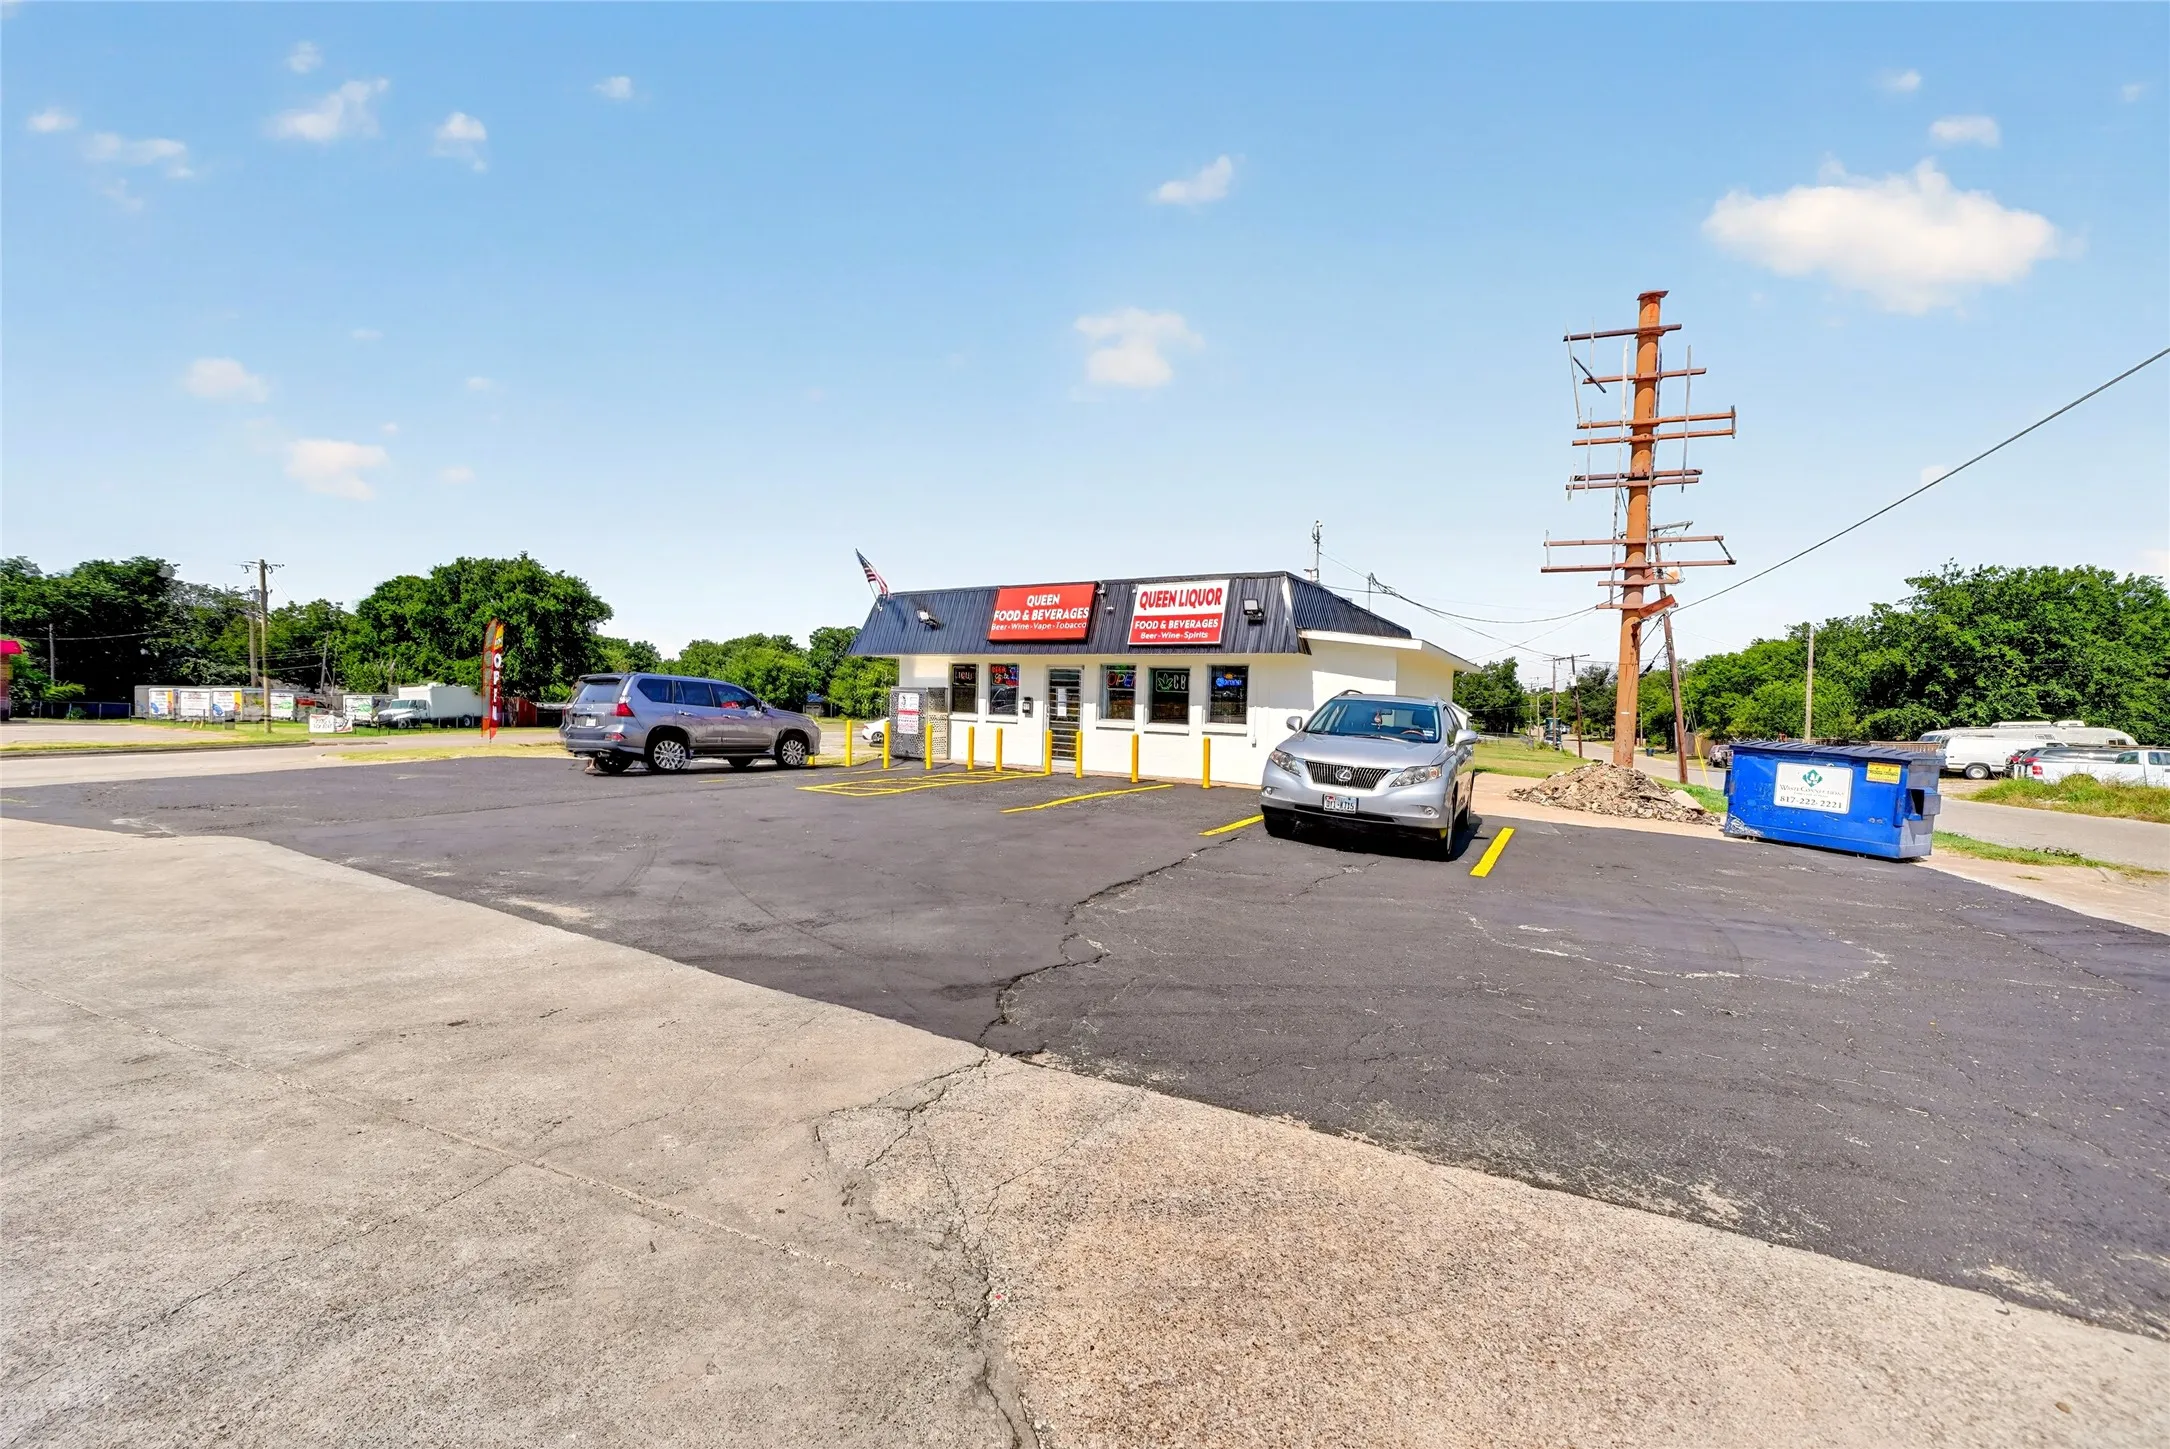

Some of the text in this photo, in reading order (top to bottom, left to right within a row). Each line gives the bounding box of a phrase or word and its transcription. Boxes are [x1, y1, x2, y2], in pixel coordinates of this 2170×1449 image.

[1026, 593, 1061, 607] QUEEN
[1139, 587, 1222, 610] QUEEN LIQUOR
[993, 607, 1090, 621] FOOD & BEVERAGES
[1135, 618, 1218, 629] FOOD & BEVERAGES
[1173, 674, 1188, 690] CB
